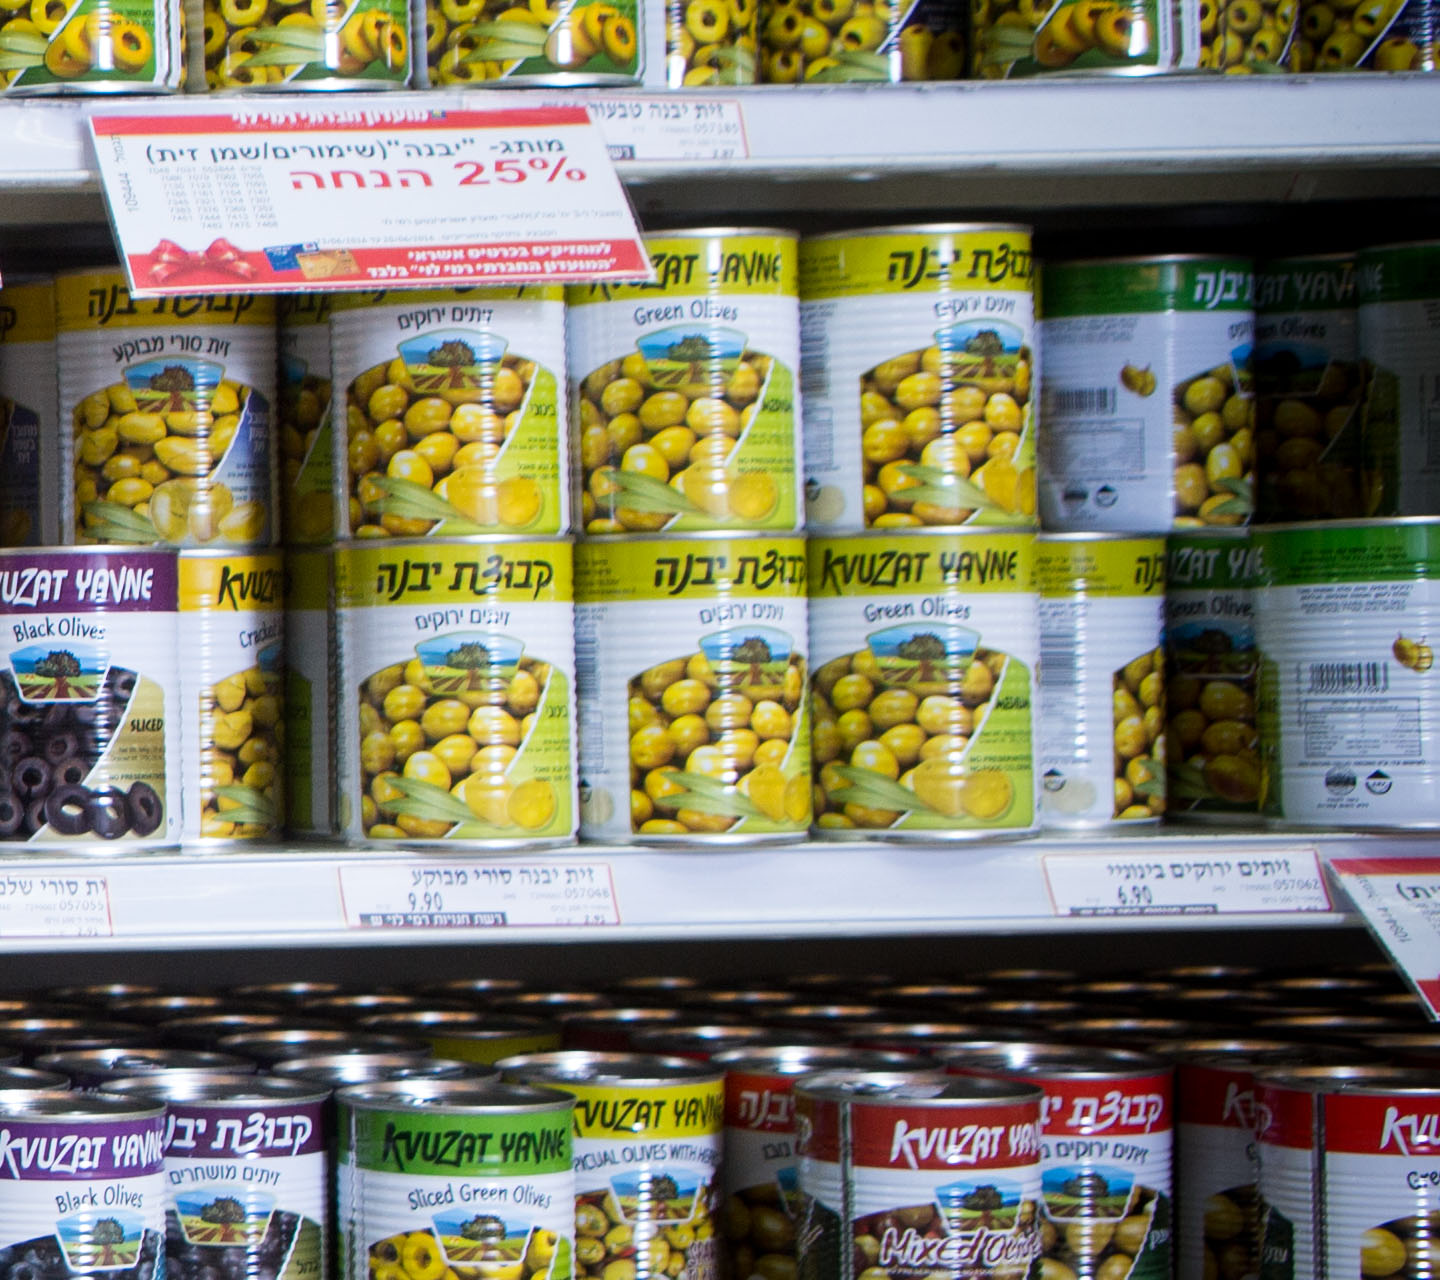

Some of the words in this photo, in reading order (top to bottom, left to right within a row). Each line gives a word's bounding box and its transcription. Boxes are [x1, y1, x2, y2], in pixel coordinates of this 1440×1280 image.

[75, 567, 154, 603] YAVNE
[377, 562, 448, 601] יבנה
[454, 554, 554, 601] קבוצת
[13, 619, 55, 643] Black
[414, 608, 465, 631] ירוקים
[471, 607, 510, 628] זיתים
[383, 1122, 497, 1171] KVUZAT
[501, 1127, 566, 1167] YAVNE
[408, 1183, 454, 1211] Sliced
[459, 1182, 508, 1203] Green
[513, 1185, 553, 1210] Olives
